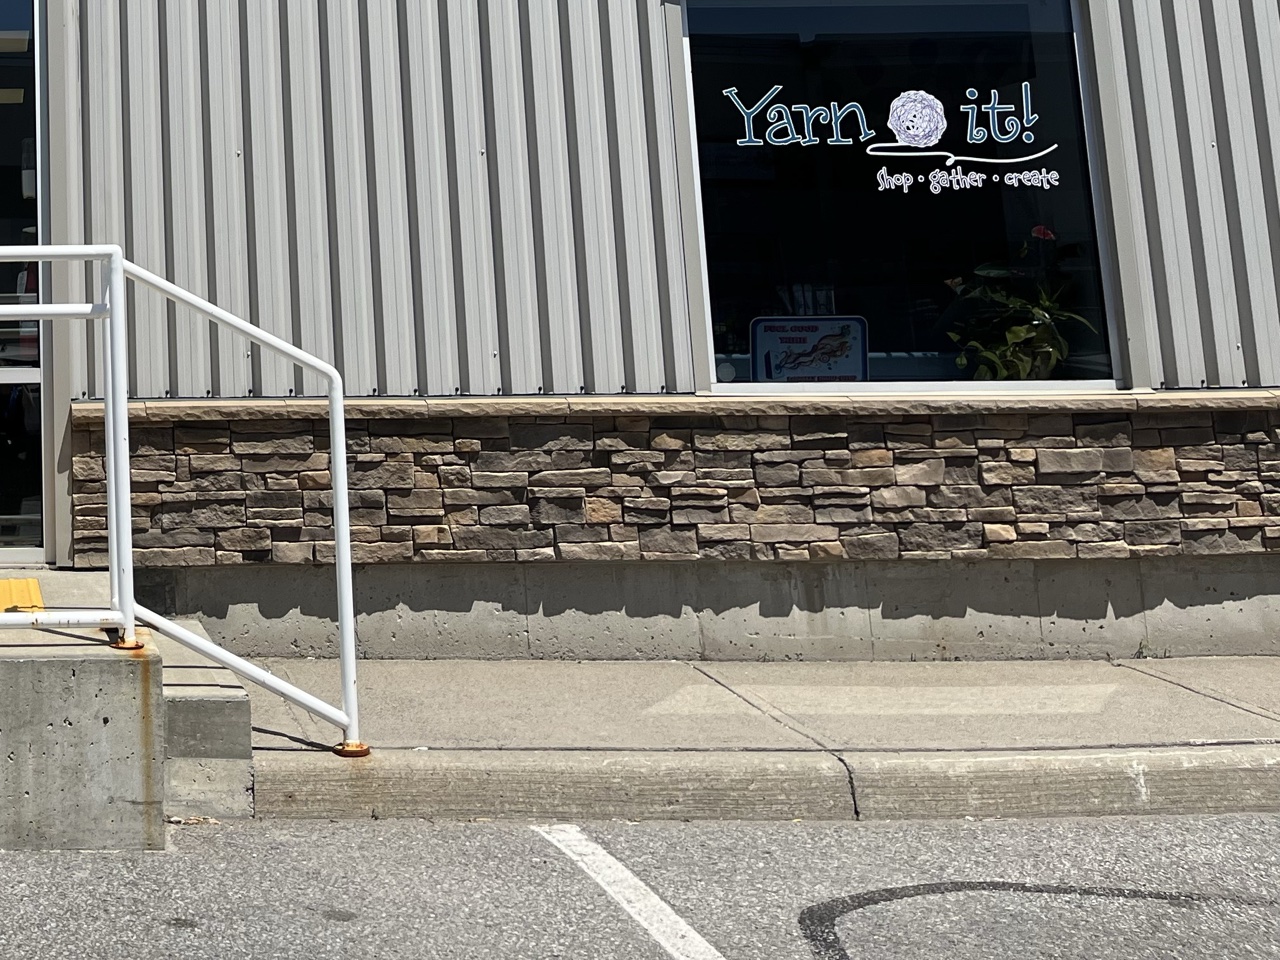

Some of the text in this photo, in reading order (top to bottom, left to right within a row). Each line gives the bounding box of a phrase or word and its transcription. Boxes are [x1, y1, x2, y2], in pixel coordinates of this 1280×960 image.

[722, 82, 1039, 146] Yarn it!
[877, 166, 1059, 194] shop gather create
